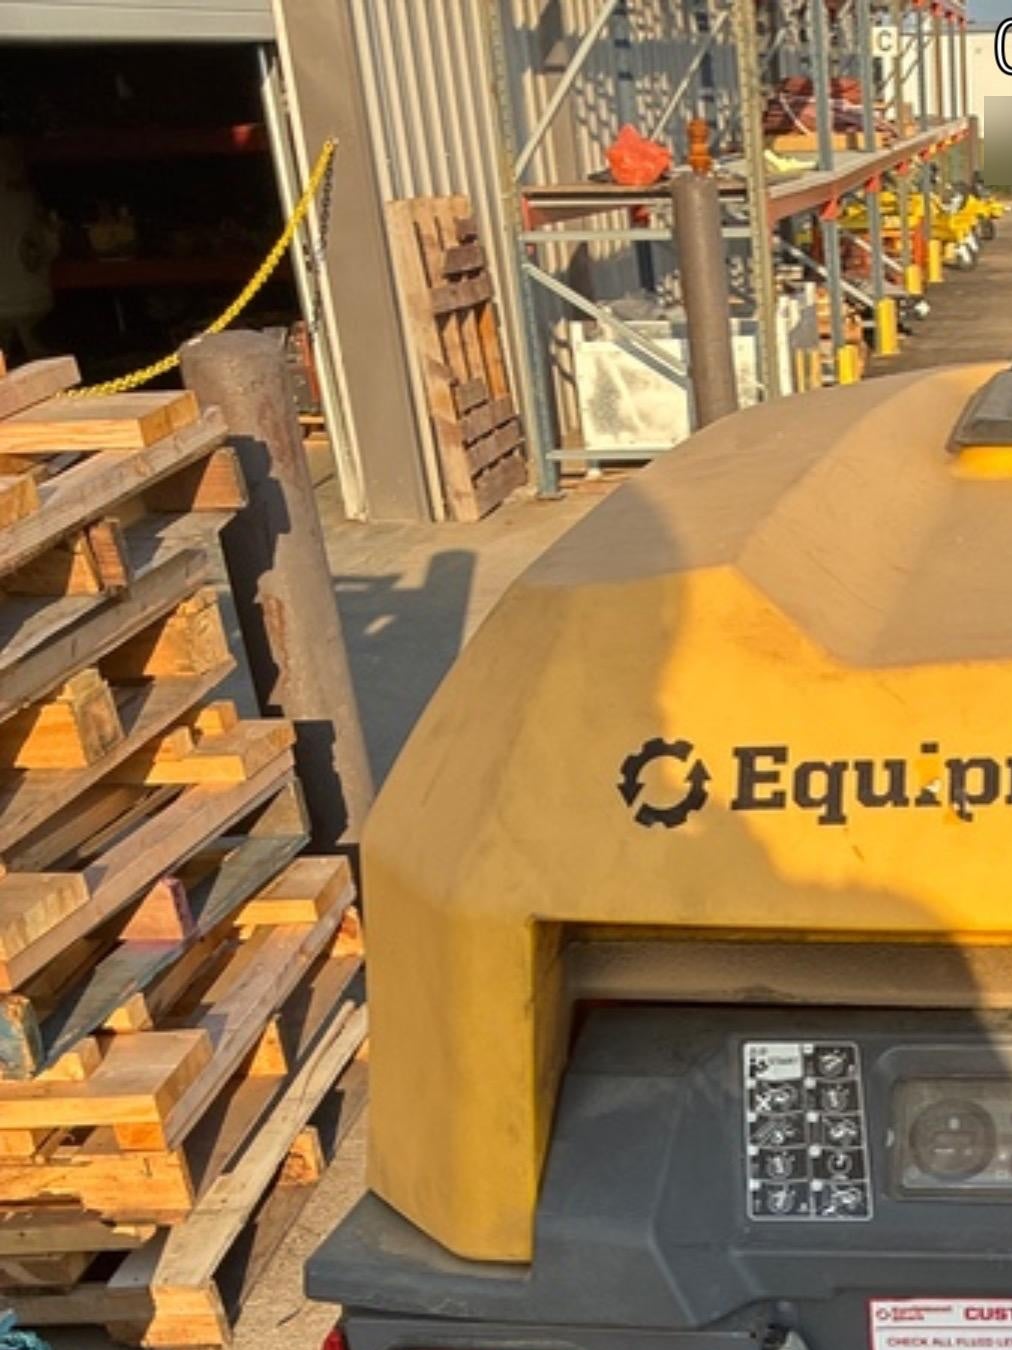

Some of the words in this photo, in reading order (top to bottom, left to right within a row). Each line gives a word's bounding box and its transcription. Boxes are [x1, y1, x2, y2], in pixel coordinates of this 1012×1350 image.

[876, 30, 892, 52] C
[887, 1336, 927, 1347] CHECK
[932, 1336, 951, 1347] ALL
[956, 1336, 993, 1347] FLUID
